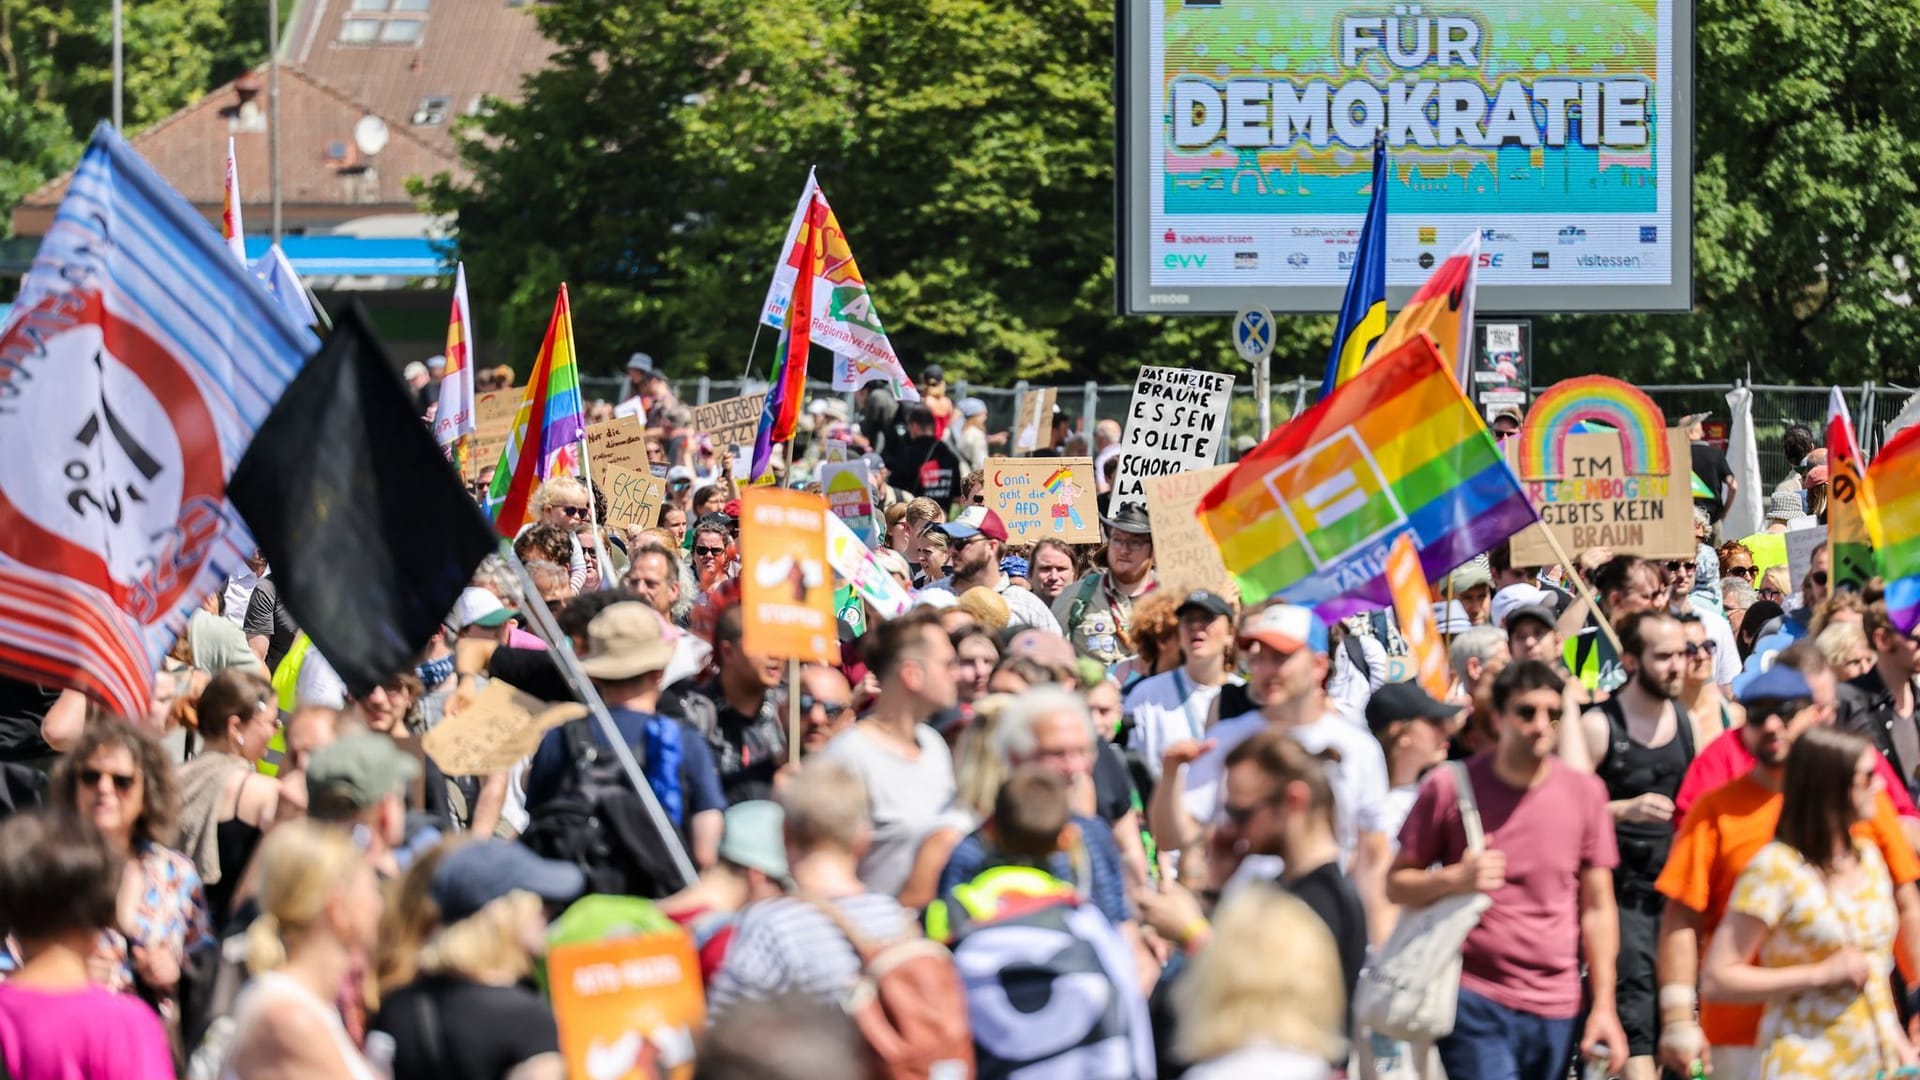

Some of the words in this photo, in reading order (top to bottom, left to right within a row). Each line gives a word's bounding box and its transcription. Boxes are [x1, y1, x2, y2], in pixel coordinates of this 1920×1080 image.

[1340, 6, 1479, 67] FÜR
[1174, 80, 1648, 147] DEMOKRATIE
[1163, 253, 1207, 269] evv
[1142, 369, 1164, 381] DAS
[1166, 371, 1224, 392] EINZIGE
[1138, 381, 1211, 408] BRAUNE
[1134, 402, 1216, 432] ESSEN
[606, 428, 621, 438] die
[1131, 427, 1209, 458] SOLLTE
[1572, 456, 1612, 477] IM
[995, 470, 1031, 487] Conni
[1119, 479, 1146, 496] LA
[1529, 477, 1669, 503] REGENBOGEN
[1000, 488, 1021, 508] geht
[1028, 488, 1046, 500] die
[1015, 502, 1039, 516] AfD
[1541, 502, 1604, 524] GIBTS
[1613, 500, 1664, 522] KEIN
[1573, 524, 1644, 549] BRAUN
